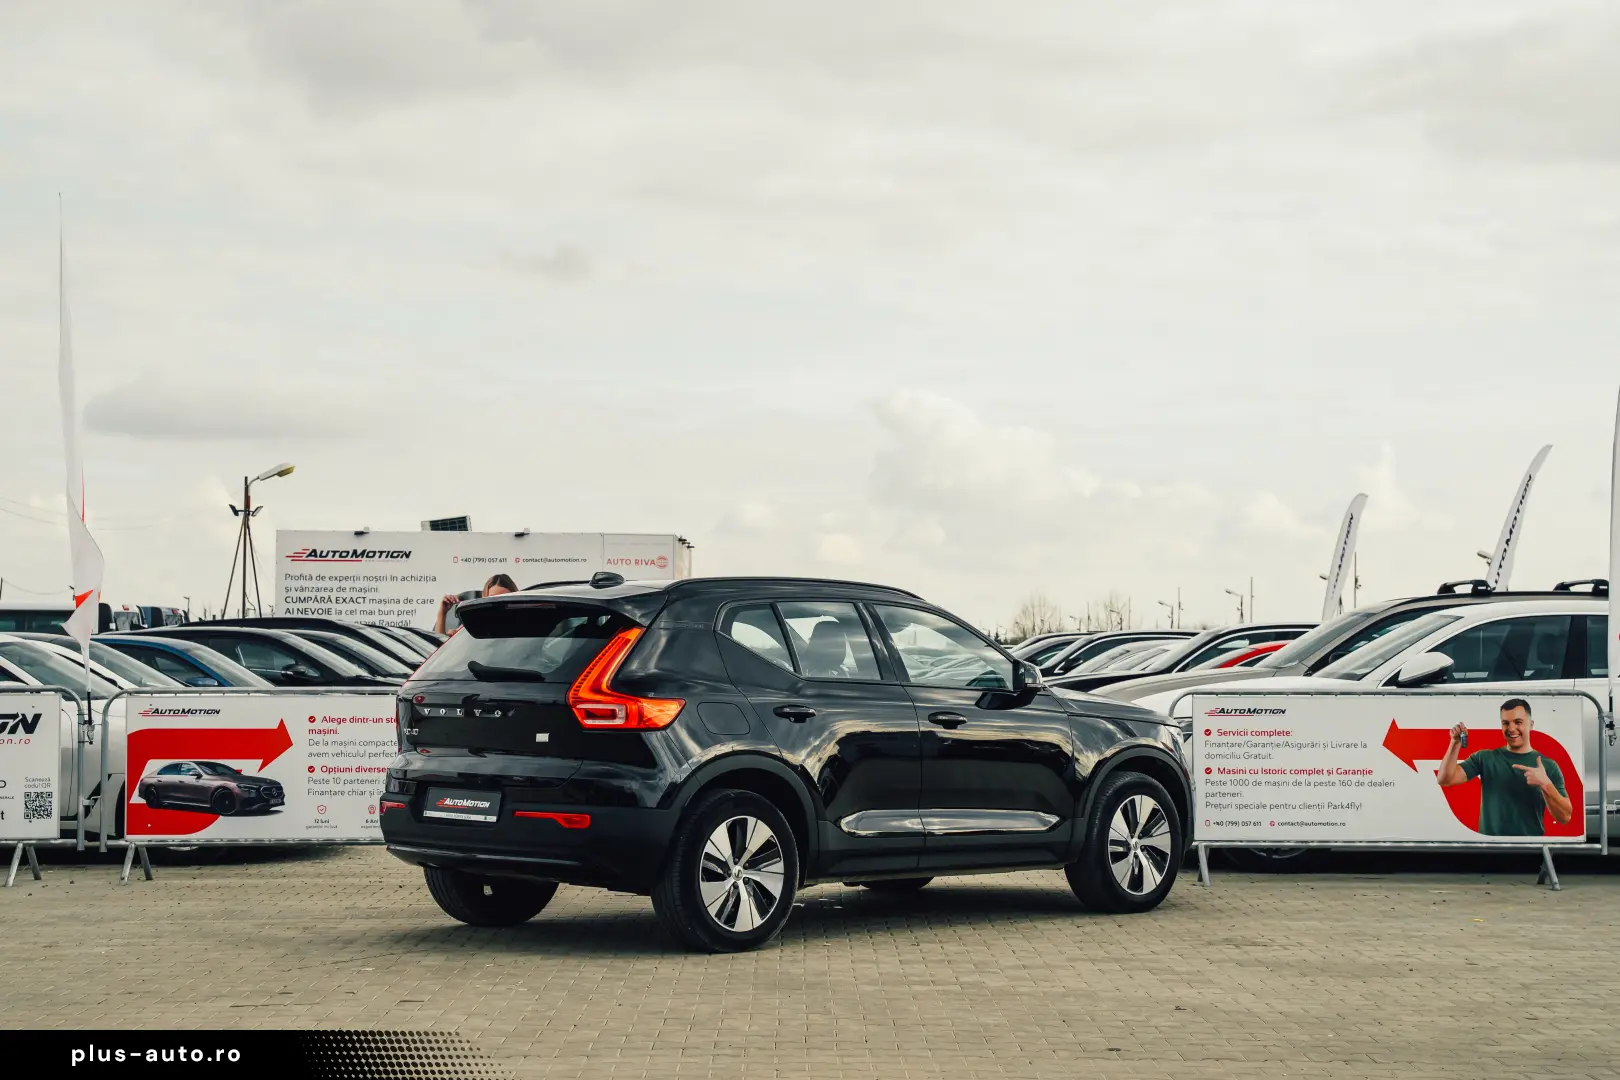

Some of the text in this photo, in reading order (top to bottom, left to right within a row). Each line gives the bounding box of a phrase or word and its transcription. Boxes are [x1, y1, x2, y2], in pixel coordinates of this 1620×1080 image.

[284, 573, 313, 582] Profită
[316, 573, 326, 582] de
[328, 574, 360, 584] experții
[362, 574, 388, 584] noștri
[400, 573, 436, 584] achiziția
[284, 595, 333, 604] CUMPĂRĂ
[368, 597, 400, 606] mașina
[296, 608, 332, 616] NEVOIE
[396, 609, 416, 618] preț!
[424, 708, 502, 718] VOLVO
[321, 716, 348, 725] Alege
[308, 728, 339, 736] mașini.
[1216, 728, 1292, 738] Servicii complete:
[322, 738, 328, 746] la
[331, 740, 356, 748] mașini
[358, 740, 398, 748] compacte
[1322, 741, 1328, 750] și
[332, 750, 366, 758] vehiculul
[368, 750, 397, 759] perfect
[1204, 752, 1274, 760] domiciliu Gratuit.
[320, 766, 352, 774] Opțiuni
[1290, 768, 1324, 776] complet
[1336, 768, 1373, 777] Garanție
[343, 777, 380, 786] parteneri
[1205, 778, 1228, 786] Peste
[1230, 778, 1250, 786] 1000
[1264, 780, 1290, 788] mașini
[308, 788, 345, 798] Finanțare
[369, 788, 374, 798] și
[1205, 791, 1244, 799] parteneri.
[1205, 801, 1362, 812] Prețuri speciale pentru clienții Park4fly!
